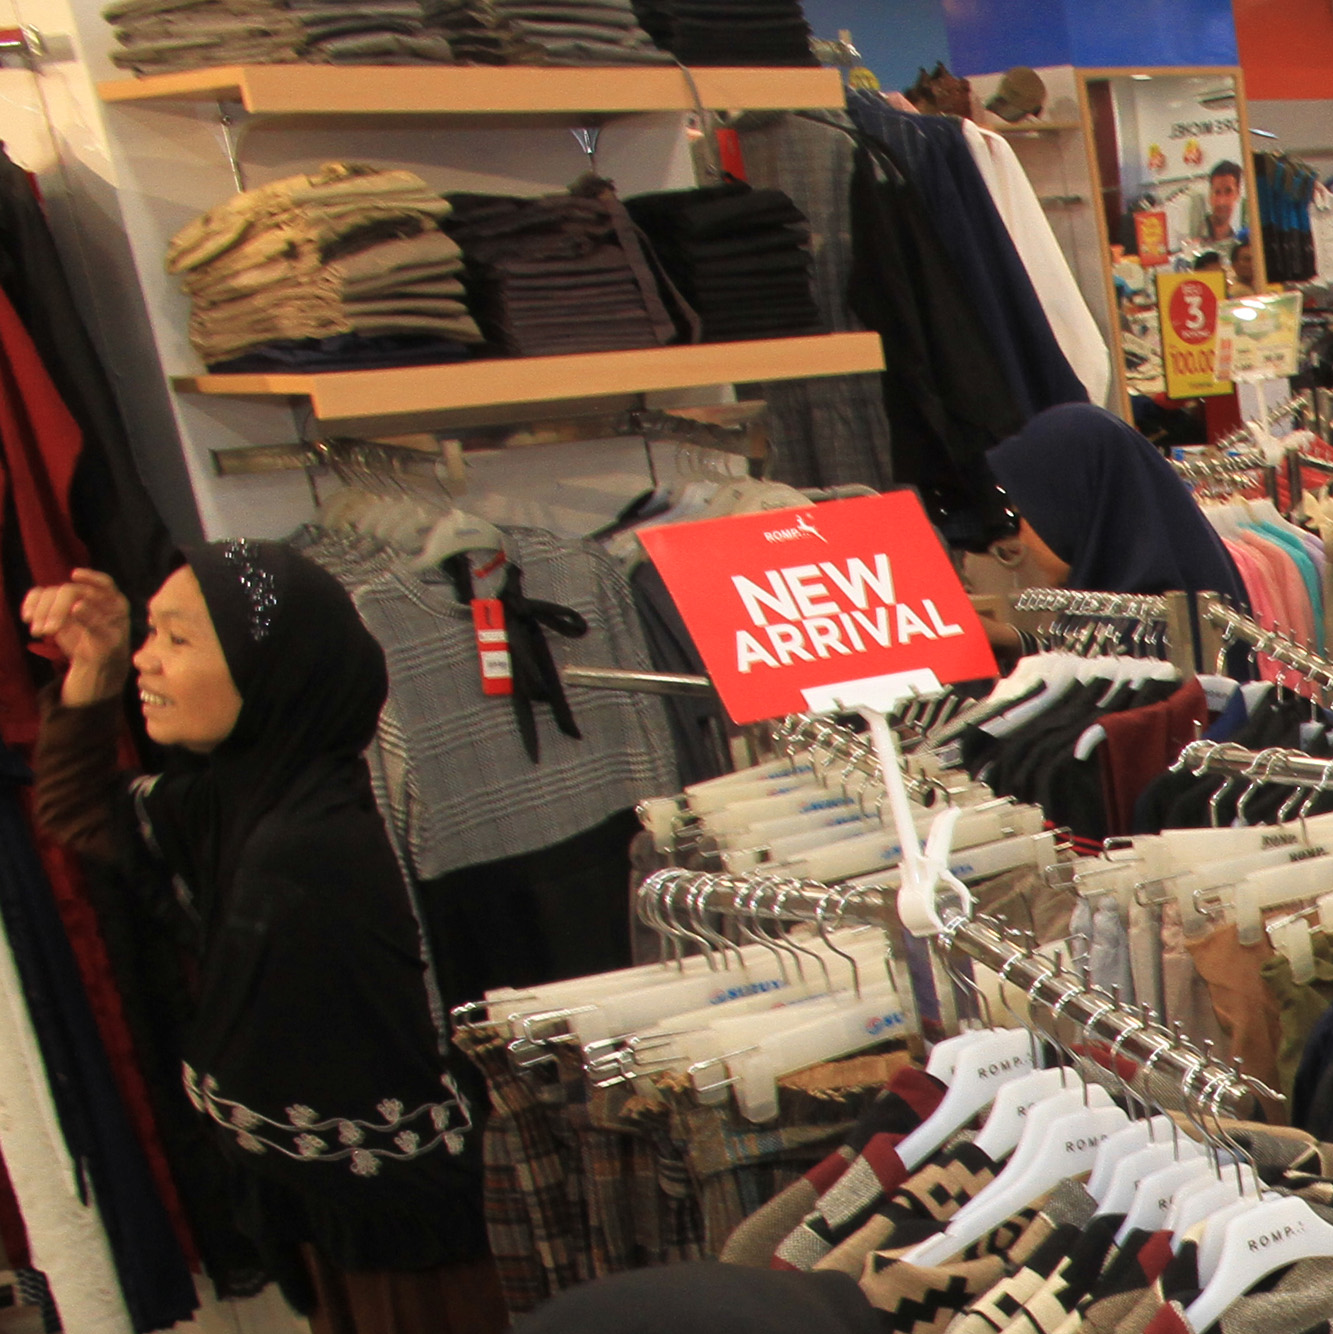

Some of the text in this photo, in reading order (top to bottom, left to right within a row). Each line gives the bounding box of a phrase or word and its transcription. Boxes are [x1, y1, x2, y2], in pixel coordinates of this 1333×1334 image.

[1182, 295, 1206, 330] 3
[730, 553, 898, 627] NEW
[736, 598, 965, 673] ARRIVAL
